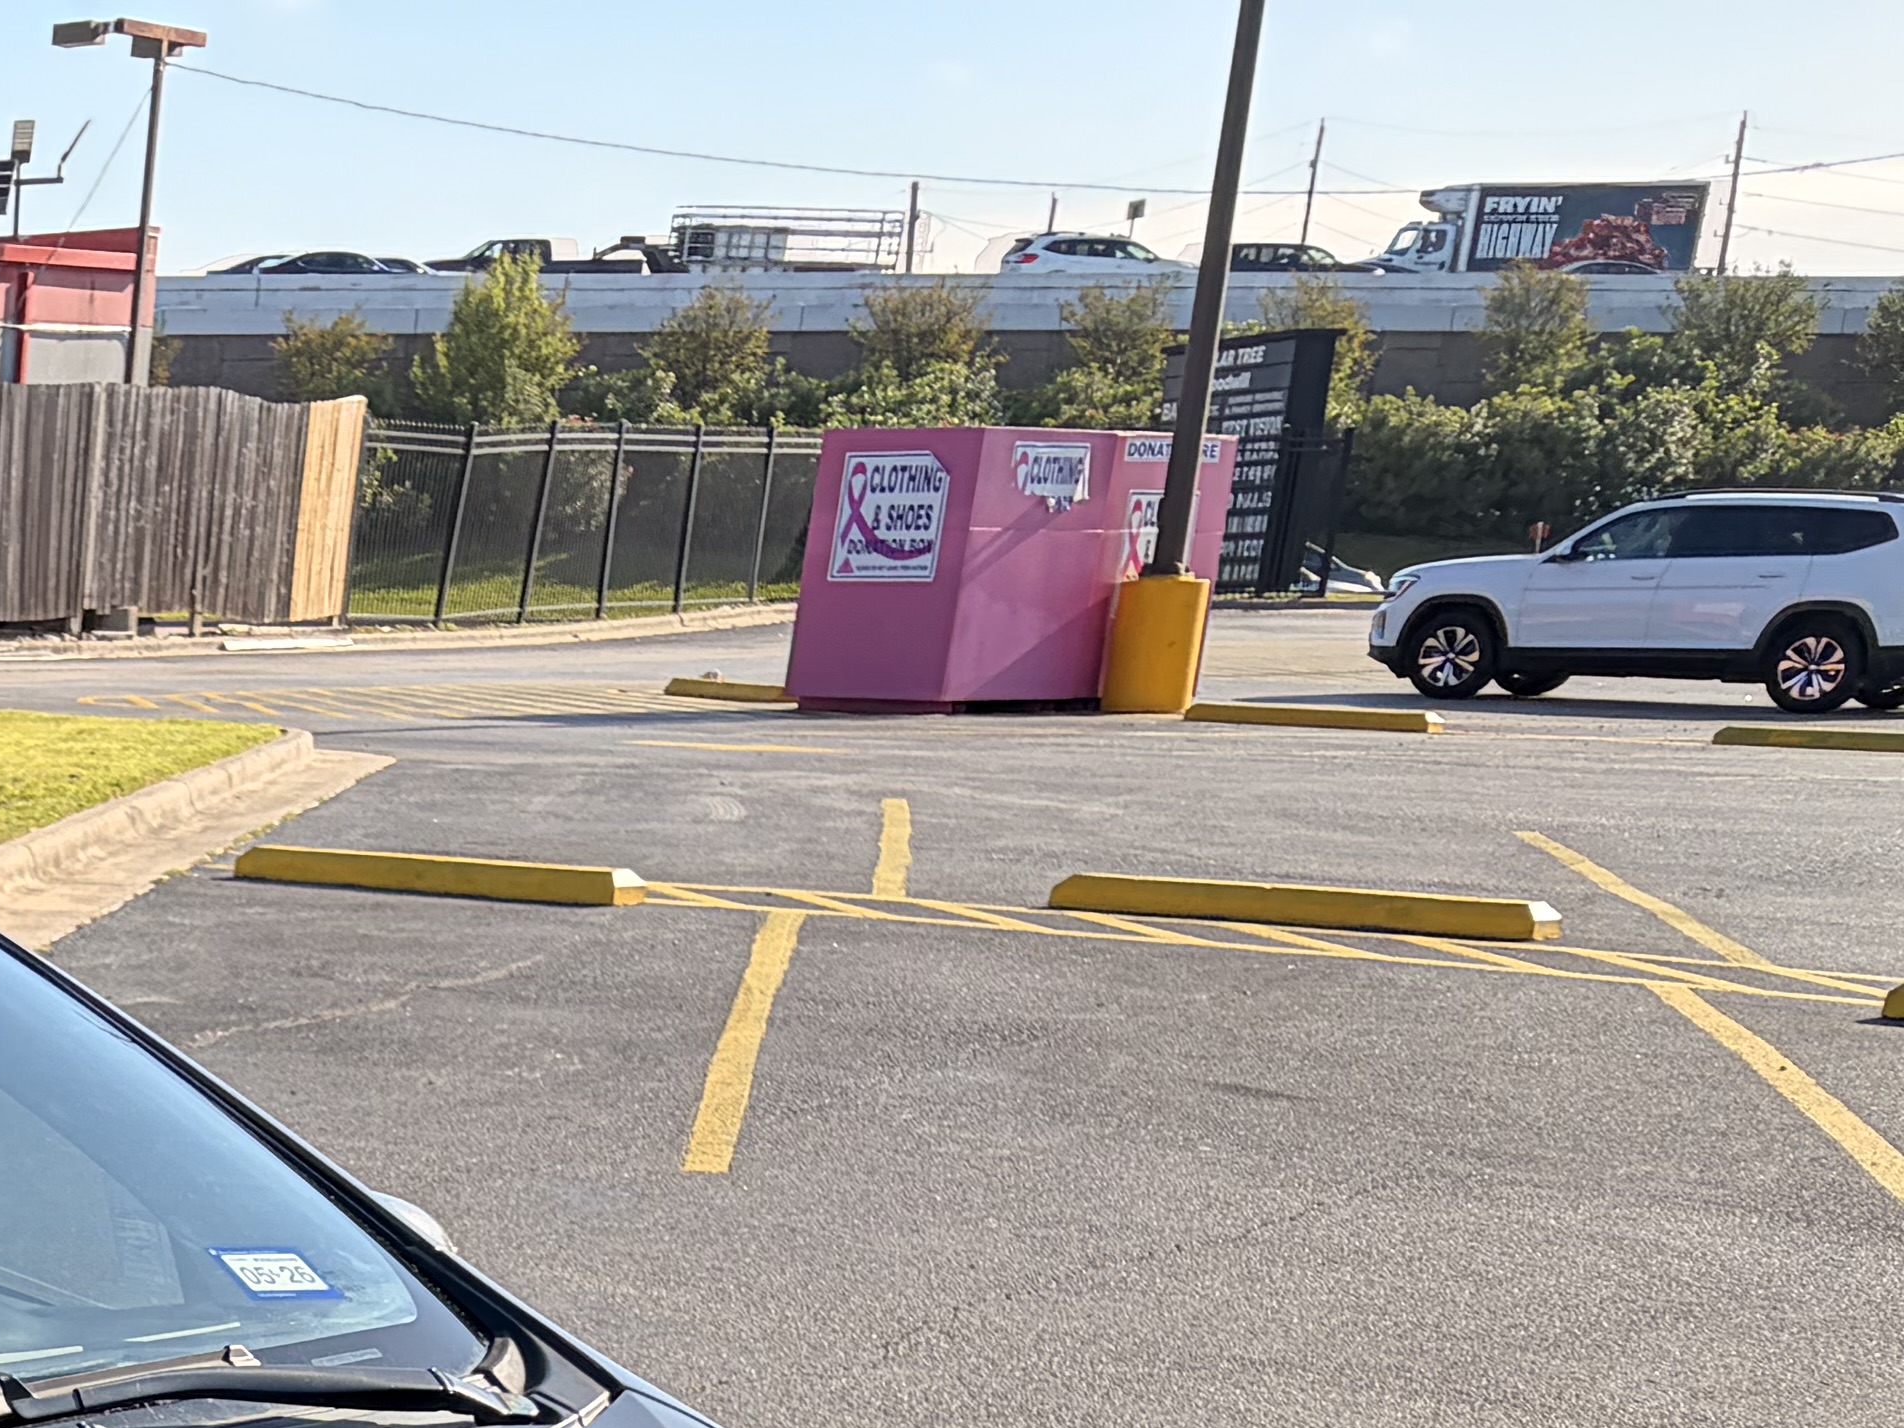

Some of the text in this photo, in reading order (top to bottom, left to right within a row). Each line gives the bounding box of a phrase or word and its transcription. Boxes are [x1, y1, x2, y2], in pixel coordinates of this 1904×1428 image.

[1484, 196, 1563, 213] FRYIN'
[1476, 223, 1558, 258] HIGHWAY
[1237, 345, 1266, 364] TREE
[1128, 441, 1173, 457] DONAT
[1202, 443, 1218, 459] RE
[870, 465, 943, 494] CLOTHING
[1030, 455, 1084, 485] CLOTHING
[872, 504, 934, 531] & SHOES
